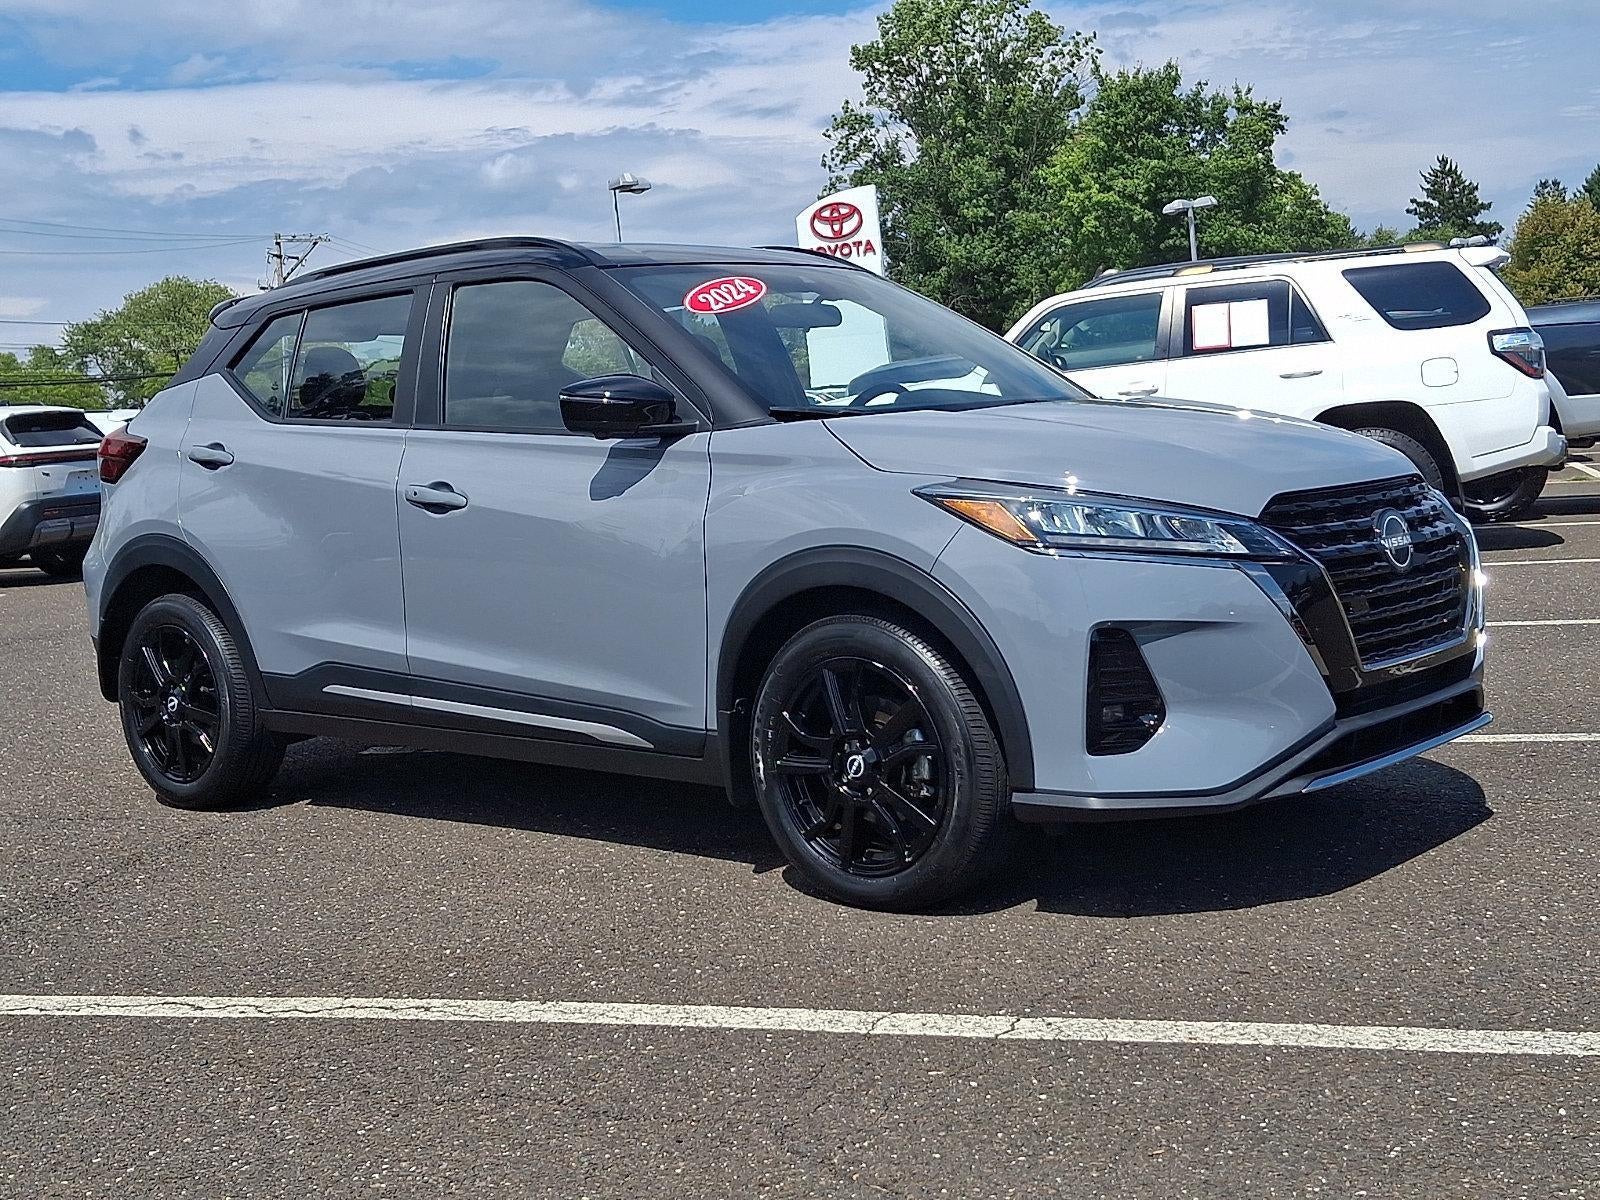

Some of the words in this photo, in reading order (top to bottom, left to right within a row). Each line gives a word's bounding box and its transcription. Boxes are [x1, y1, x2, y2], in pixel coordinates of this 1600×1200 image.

[810, 239, 877, 259] YOTA
[698, 279, 758, 311] 2024
[1380, 534, 1412, 549] NISSAN
